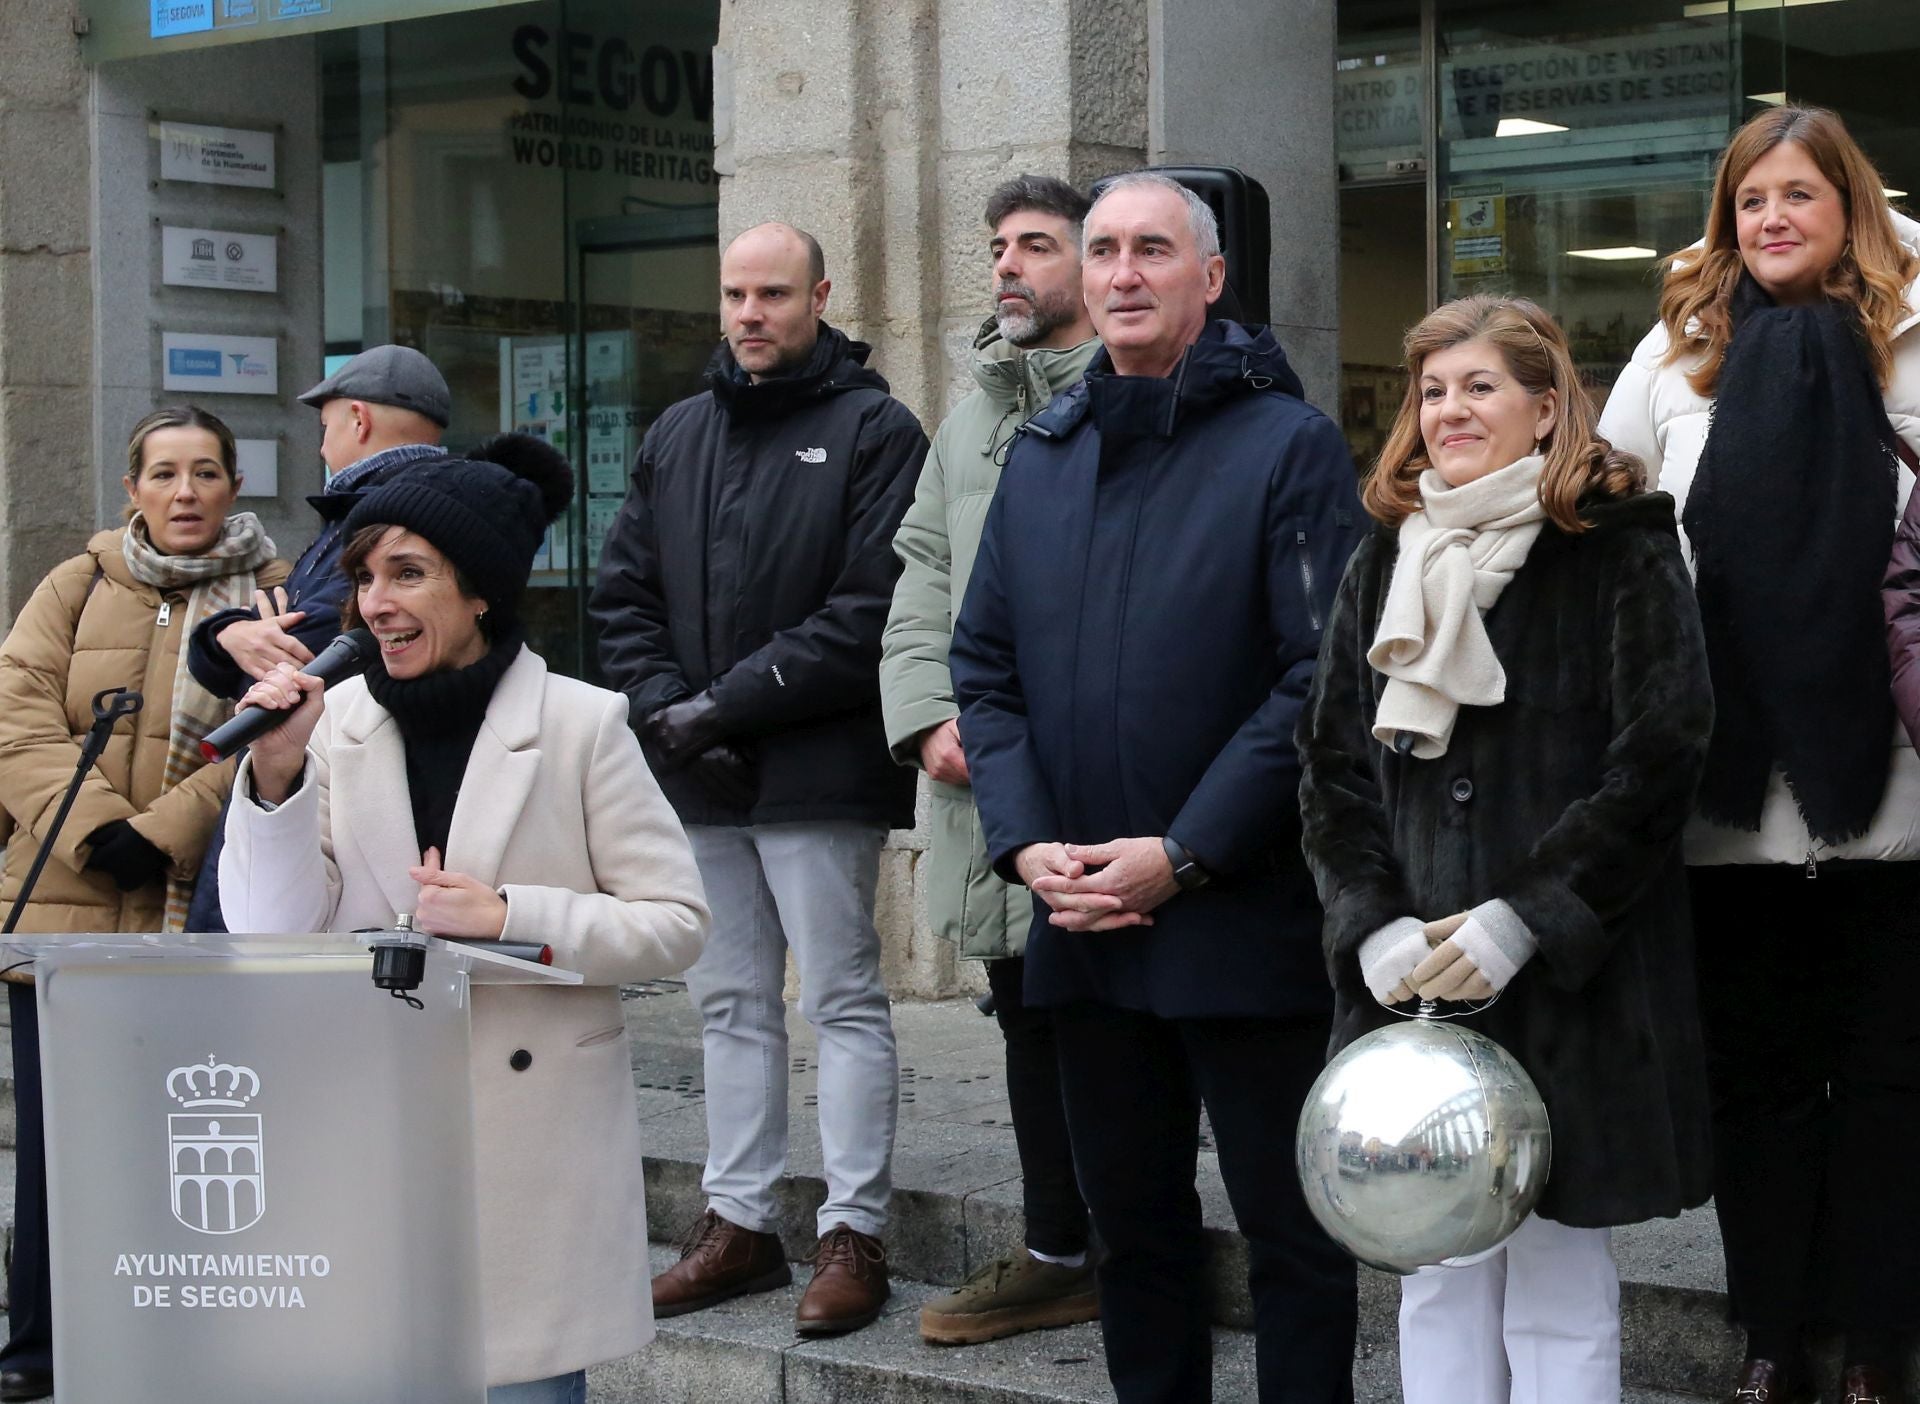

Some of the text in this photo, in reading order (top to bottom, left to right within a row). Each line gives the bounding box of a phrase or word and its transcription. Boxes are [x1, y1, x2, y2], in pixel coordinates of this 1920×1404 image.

[170, 4, 205, 21] SEGOVIA
[1586, 52, 1617, 76] DE
[1485, 82, 1612, 114] RESERVAS
[1619, 77, 1654, 101] DE
[512, 113, 625, 142] PATRIMONIO
[630, 127, 649, 146] DE
[655, 129, 674, 149] LA
[512, 136, 603, 171] WORLD
[223, 160, 267, 172] Humanidad
[114, 1254, 330, 1277] AYUNTAMIENTO
[133, 1285, 306, 1308] DE SEGOVIA
